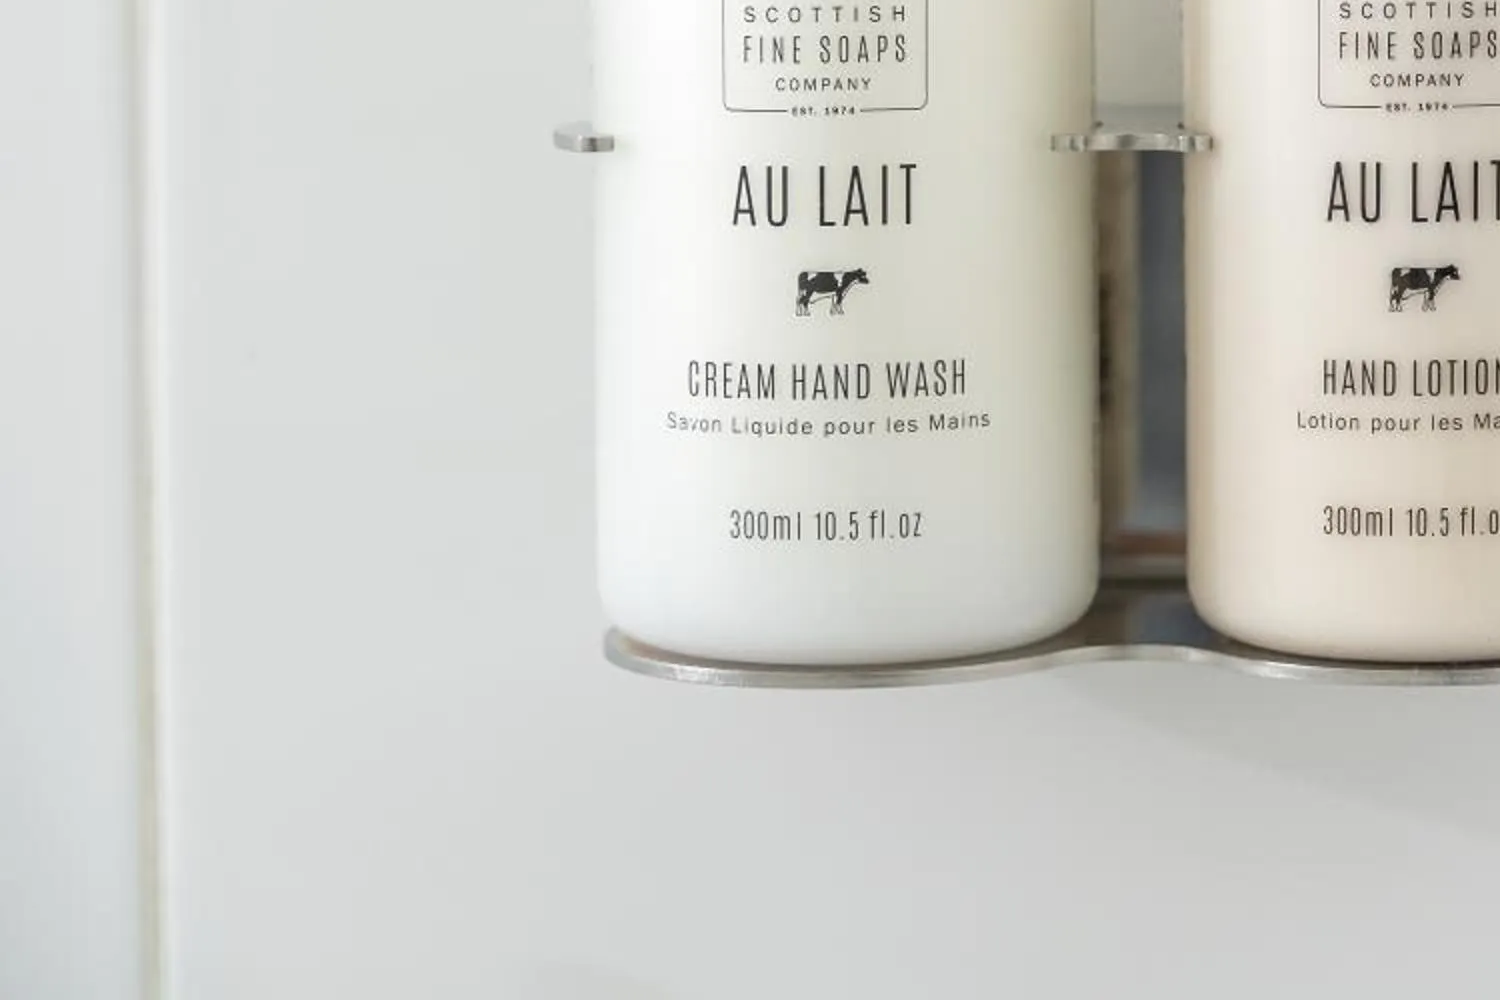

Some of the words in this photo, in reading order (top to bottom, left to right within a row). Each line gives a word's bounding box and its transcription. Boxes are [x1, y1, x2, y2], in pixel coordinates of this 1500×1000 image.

[743, 5, 906, 24] SCOTTISH
[1339, 1, 1498, 20] SCOTTISH
[743, 34, 802, 65] FINE
[818, 33, 907, 65] SOAPS
[1339, 30, 1398, 61] FINE
[1413, 28, 1498, 61] SOAPS
[775, 77, 872, 92] COMPANY
[1369, 73, 1465, 88] COMPANY
[732, 164, 789, 228] AU
[818, 163, 918, 227] LAIT
[1326, 160, 1383, 224] AU
[687, 359, 776, 401] CREAM
[791, 363, 871, 401] HAND
[885, 358, 966, 399] WASH
[1322, 359, 1398, 397] HAND
[666, 411, 722, 433] Savon
[731, 417, 814, 438] Liquide
[824, 421, 877, 437] pour
[886, 417, 919, 434] les
[929, 411, 992, 431] Mains
[1297, 411, 1360, 431] Lotion
[1371, 416, 1422, 435] pour
[1431, 413, 1464, 431] les
[729, 509, 802, 541] 300ml
[815, 510, 860, 541] 10.5
[868, 509, 923, 540] fl.oz
[1322, 505, 1394, 537] 300ml
[1406, 507, 1450, 537] 10.5
